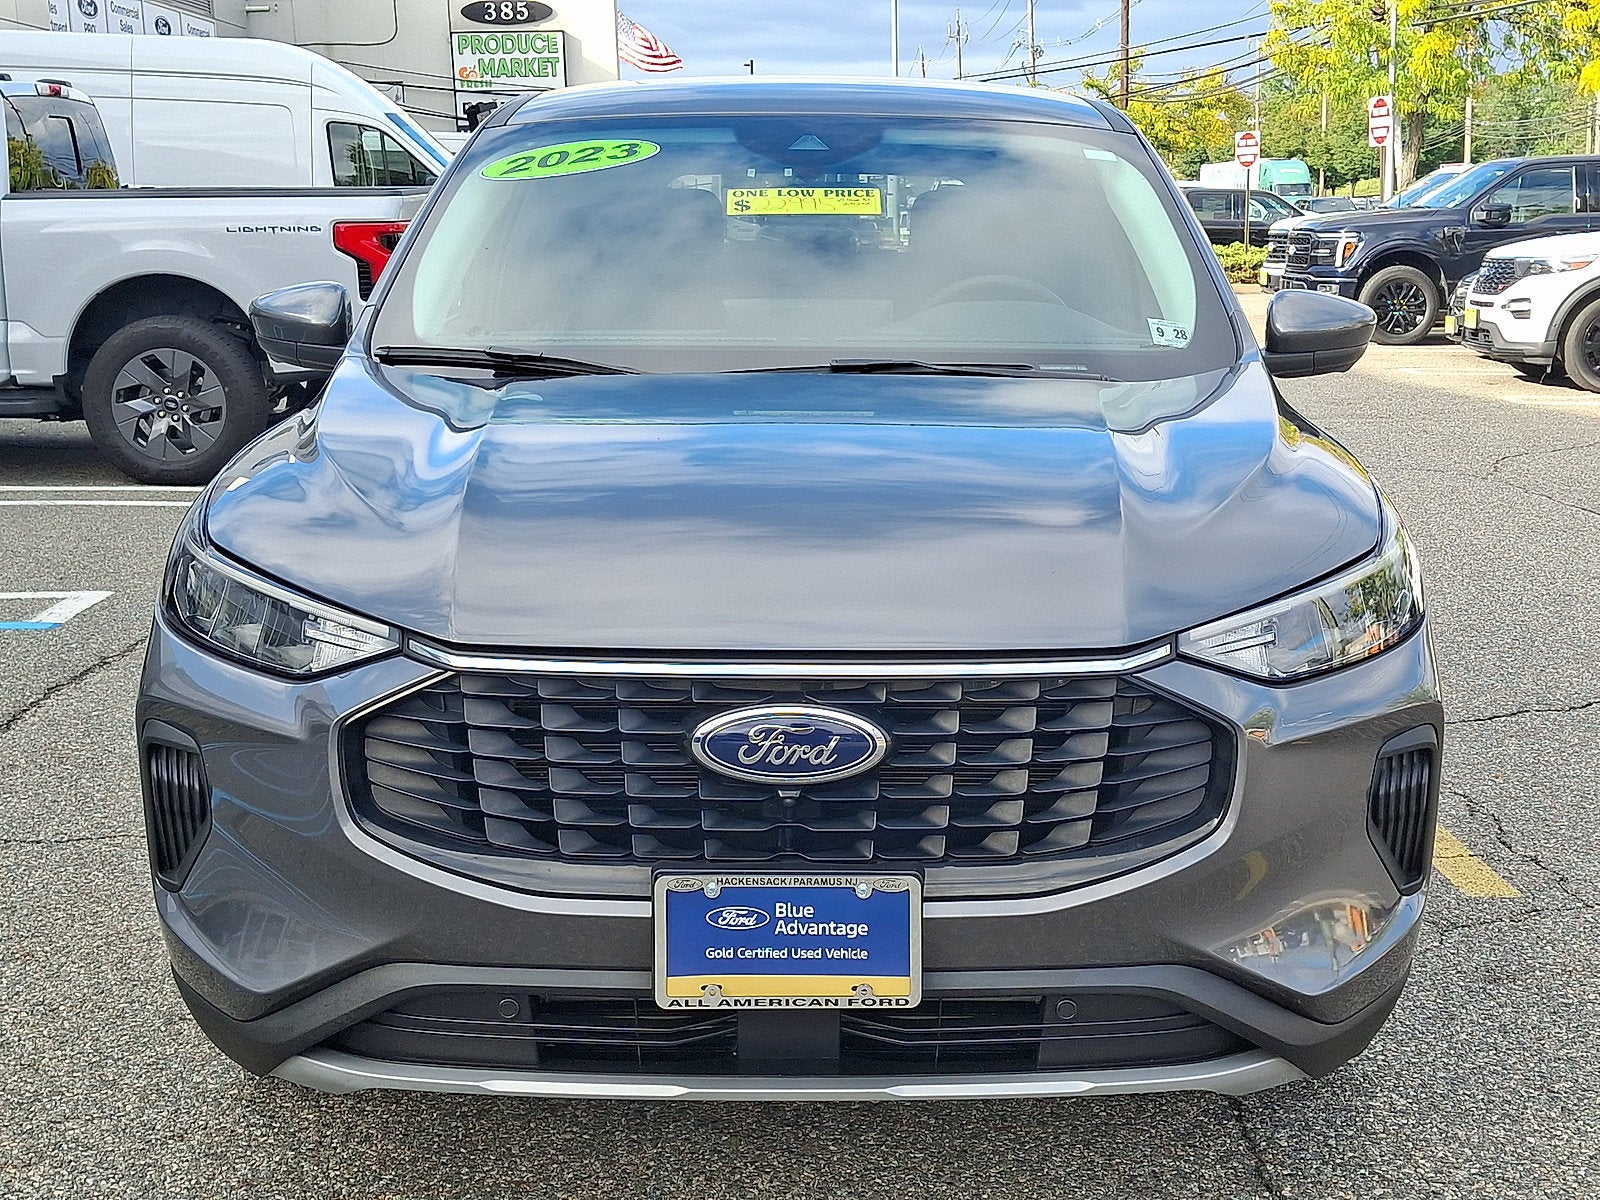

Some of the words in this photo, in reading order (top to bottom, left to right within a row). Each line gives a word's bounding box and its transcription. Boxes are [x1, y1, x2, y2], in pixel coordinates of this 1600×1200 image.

[110, 0, 139, 20] Commercial
[484, 1, 529, 21] 385
[120, 19, 134, 34] Sales
[457, 33, 559, 55] PRODUCE
[478, 57, 560, 79] MARKET
[499, 143, 641, 176] 2023
[732, 189, 768, 198] ONE
[777, 189, 815, 198] LOW
[824, 189, 876, 198] PRICE
[225, 225, 322, 235] LIGHTNING
[1156, 326, 1165, 338] 9
[1173, 328, 1188, 340] 28
[737, 723, 841, 766] Ford
[673, 879, 697, 889] Ford
[845, 877, 858, 886] NJ
[879, 879, 902, 889] Ford
[717, 909, 758, 926] Ford
[775, 902, 815, 918] Blue
[774, 920, 869, 939] Advantage
[705, 947, 734, 959] Gold
[737, 947, 788, 959] Certified
[791, 947, 822, 959] Used
[825, 947, 869, 960] Vehicle
[667, 998, 711, 1008] ALL
[717, 998, 845, 1008] AMERICAN
[847, 998, 911, 1008] FORD
